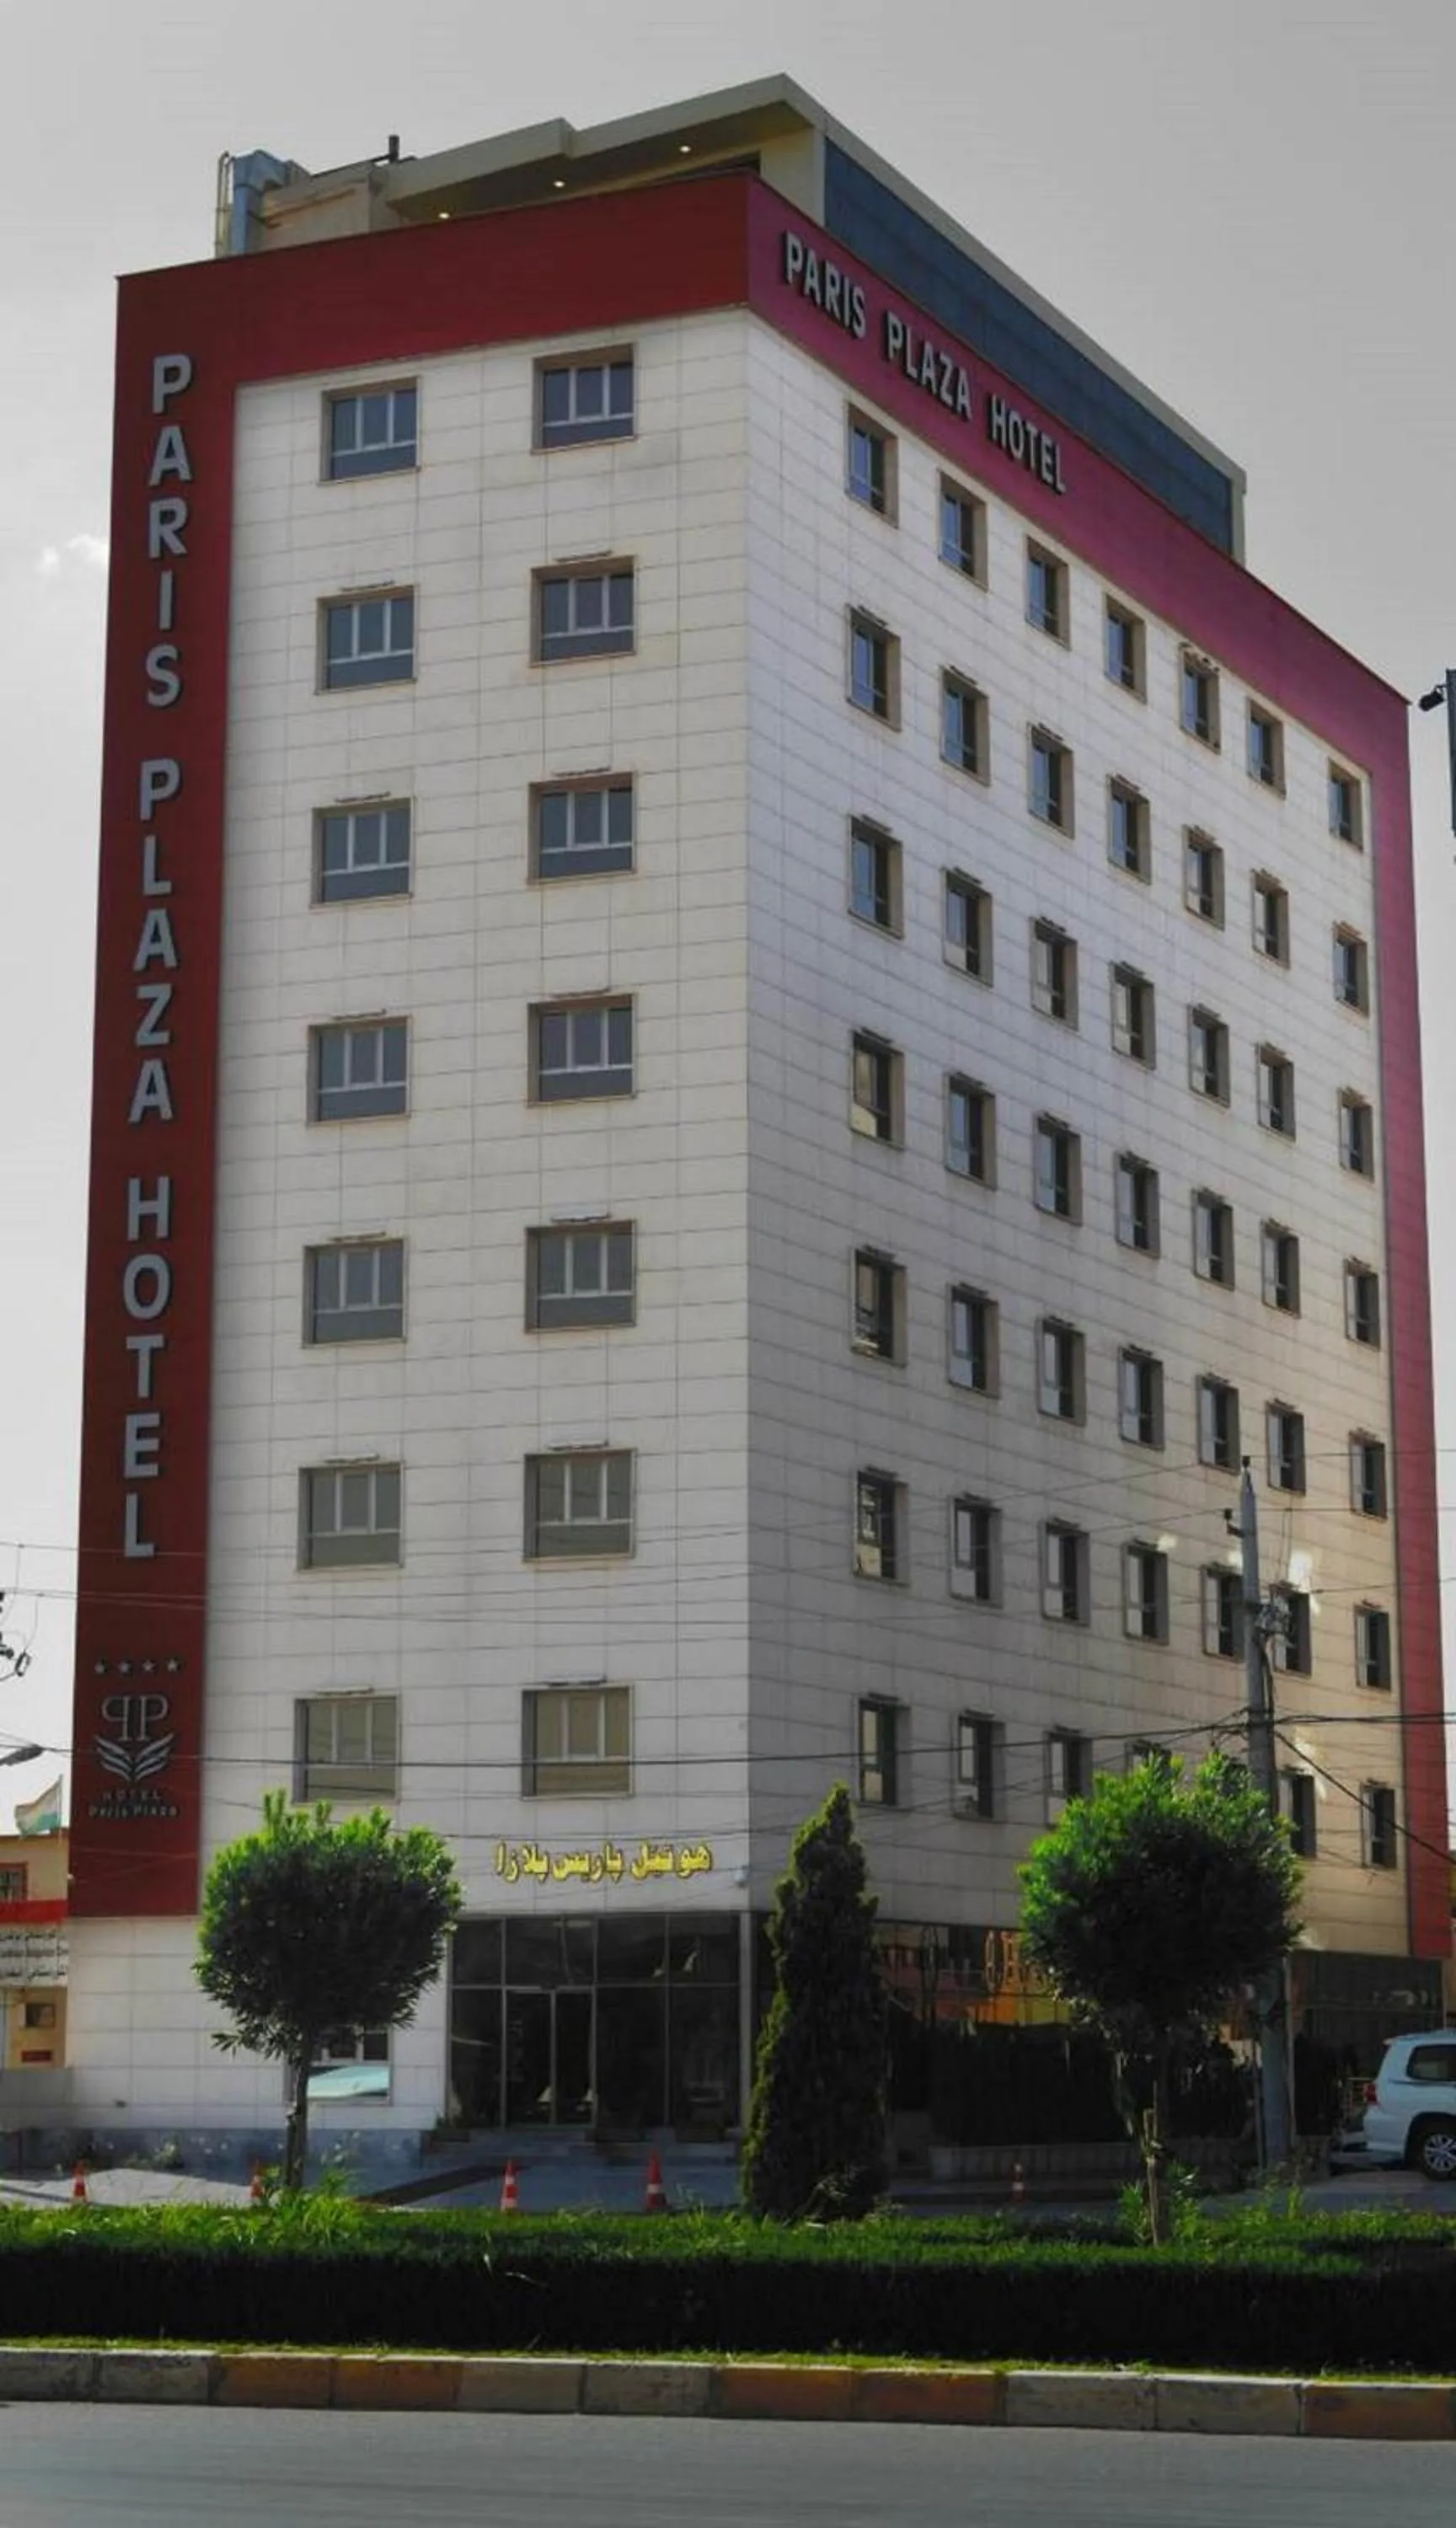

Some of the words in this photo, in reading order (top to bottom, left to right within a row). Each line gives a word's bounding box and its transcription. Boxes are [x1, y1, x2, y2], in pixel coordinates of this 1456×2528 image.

[145, 352, 193, 708] PARIS
[784, 230, 866, 339] PARIS
[885, 309, 972, 420] PLAZA
[990, 394, 1066, 495] HOTEL
[129, 757, 182, 1124] PLAZA
[123, 1175, 172, 1558] HOTEL
